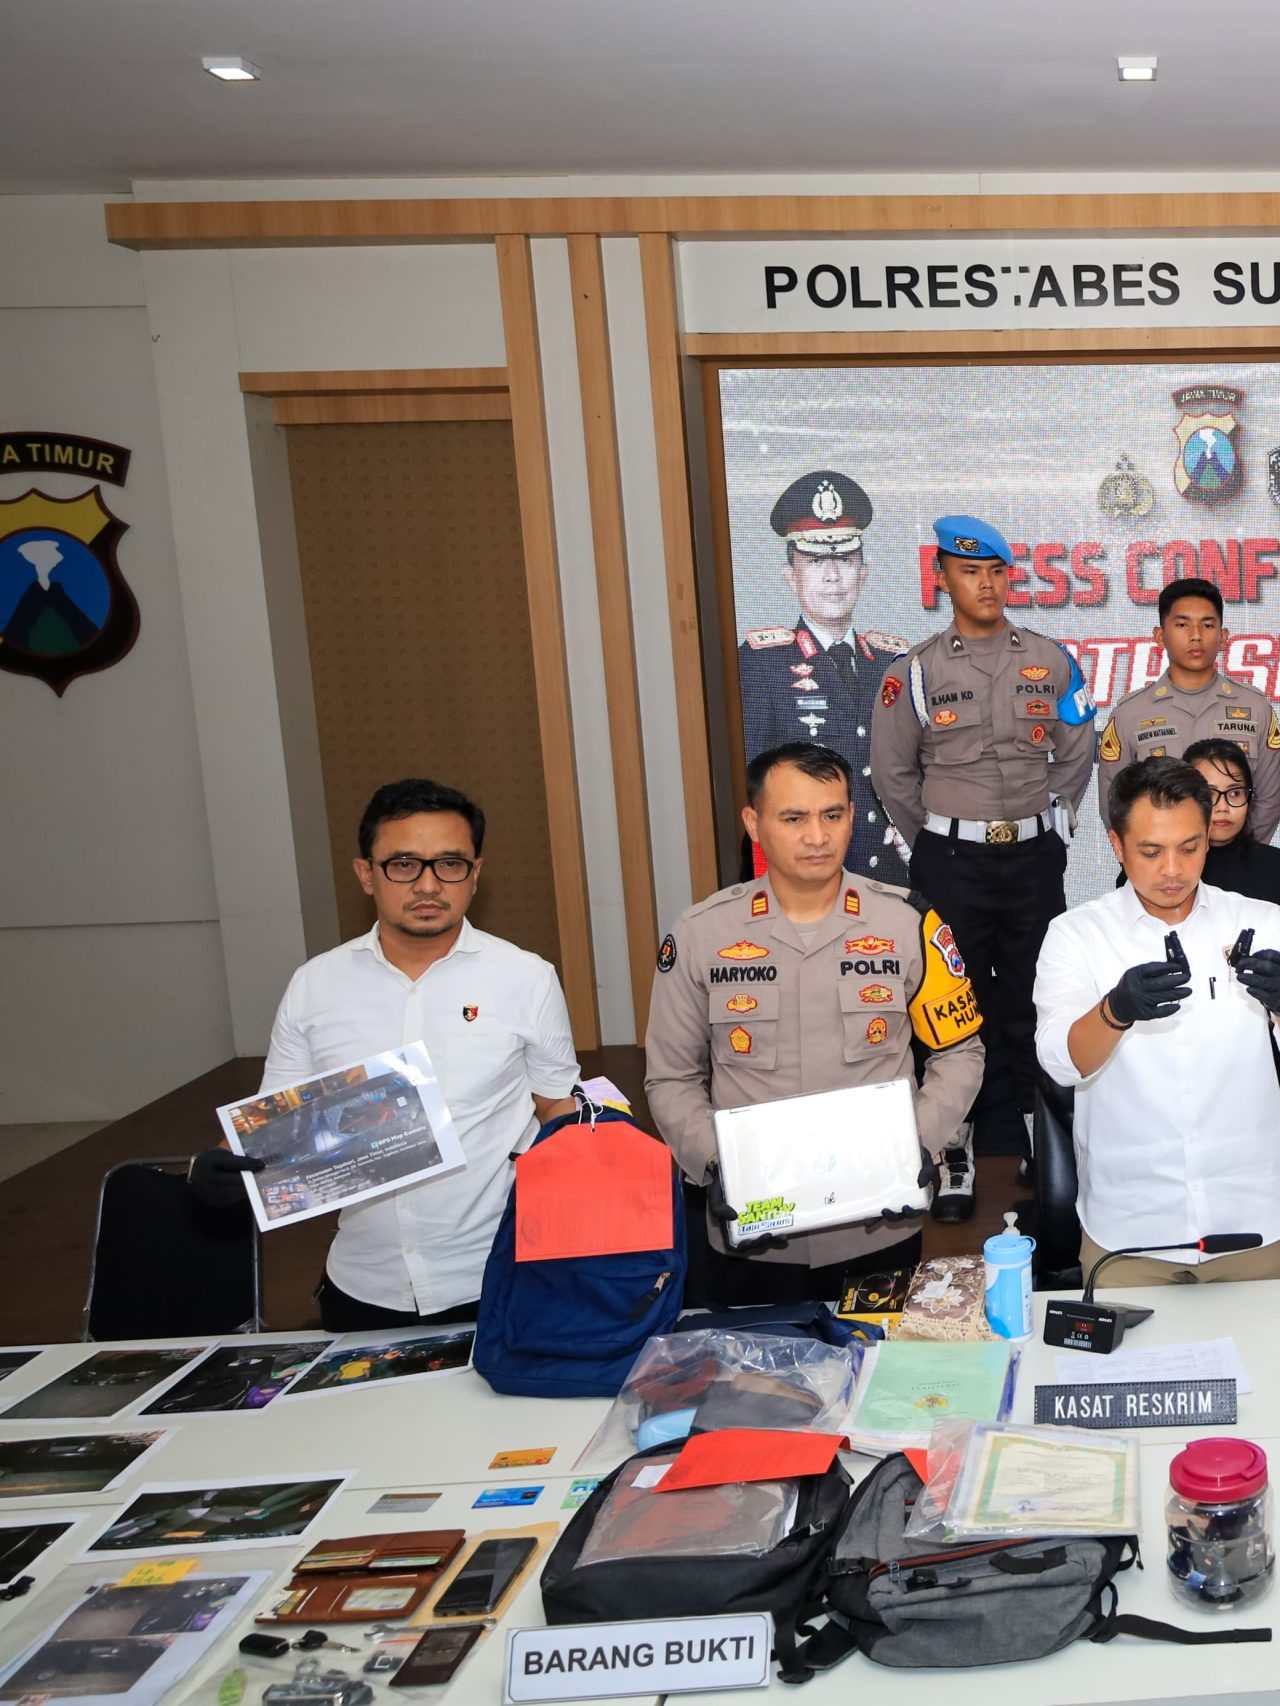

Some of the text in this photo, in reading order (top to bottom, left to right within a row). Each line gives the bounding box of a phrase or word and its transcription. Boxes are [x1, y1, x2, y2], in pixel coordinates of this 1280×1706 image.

[26, 443, 115, 474] TIMUR
[1016, 684, 1055, 696] POLRI
[1217, 723, 1257, 733] TARUNA
[710, 964, 777, 984] HARYOKO
[840, 959, 900, 977] POLRI
[1054, 1390, 1213, 1419] KASAT RESKRIM
[524, 1635, 755, 1676] BARANG BUKTI
